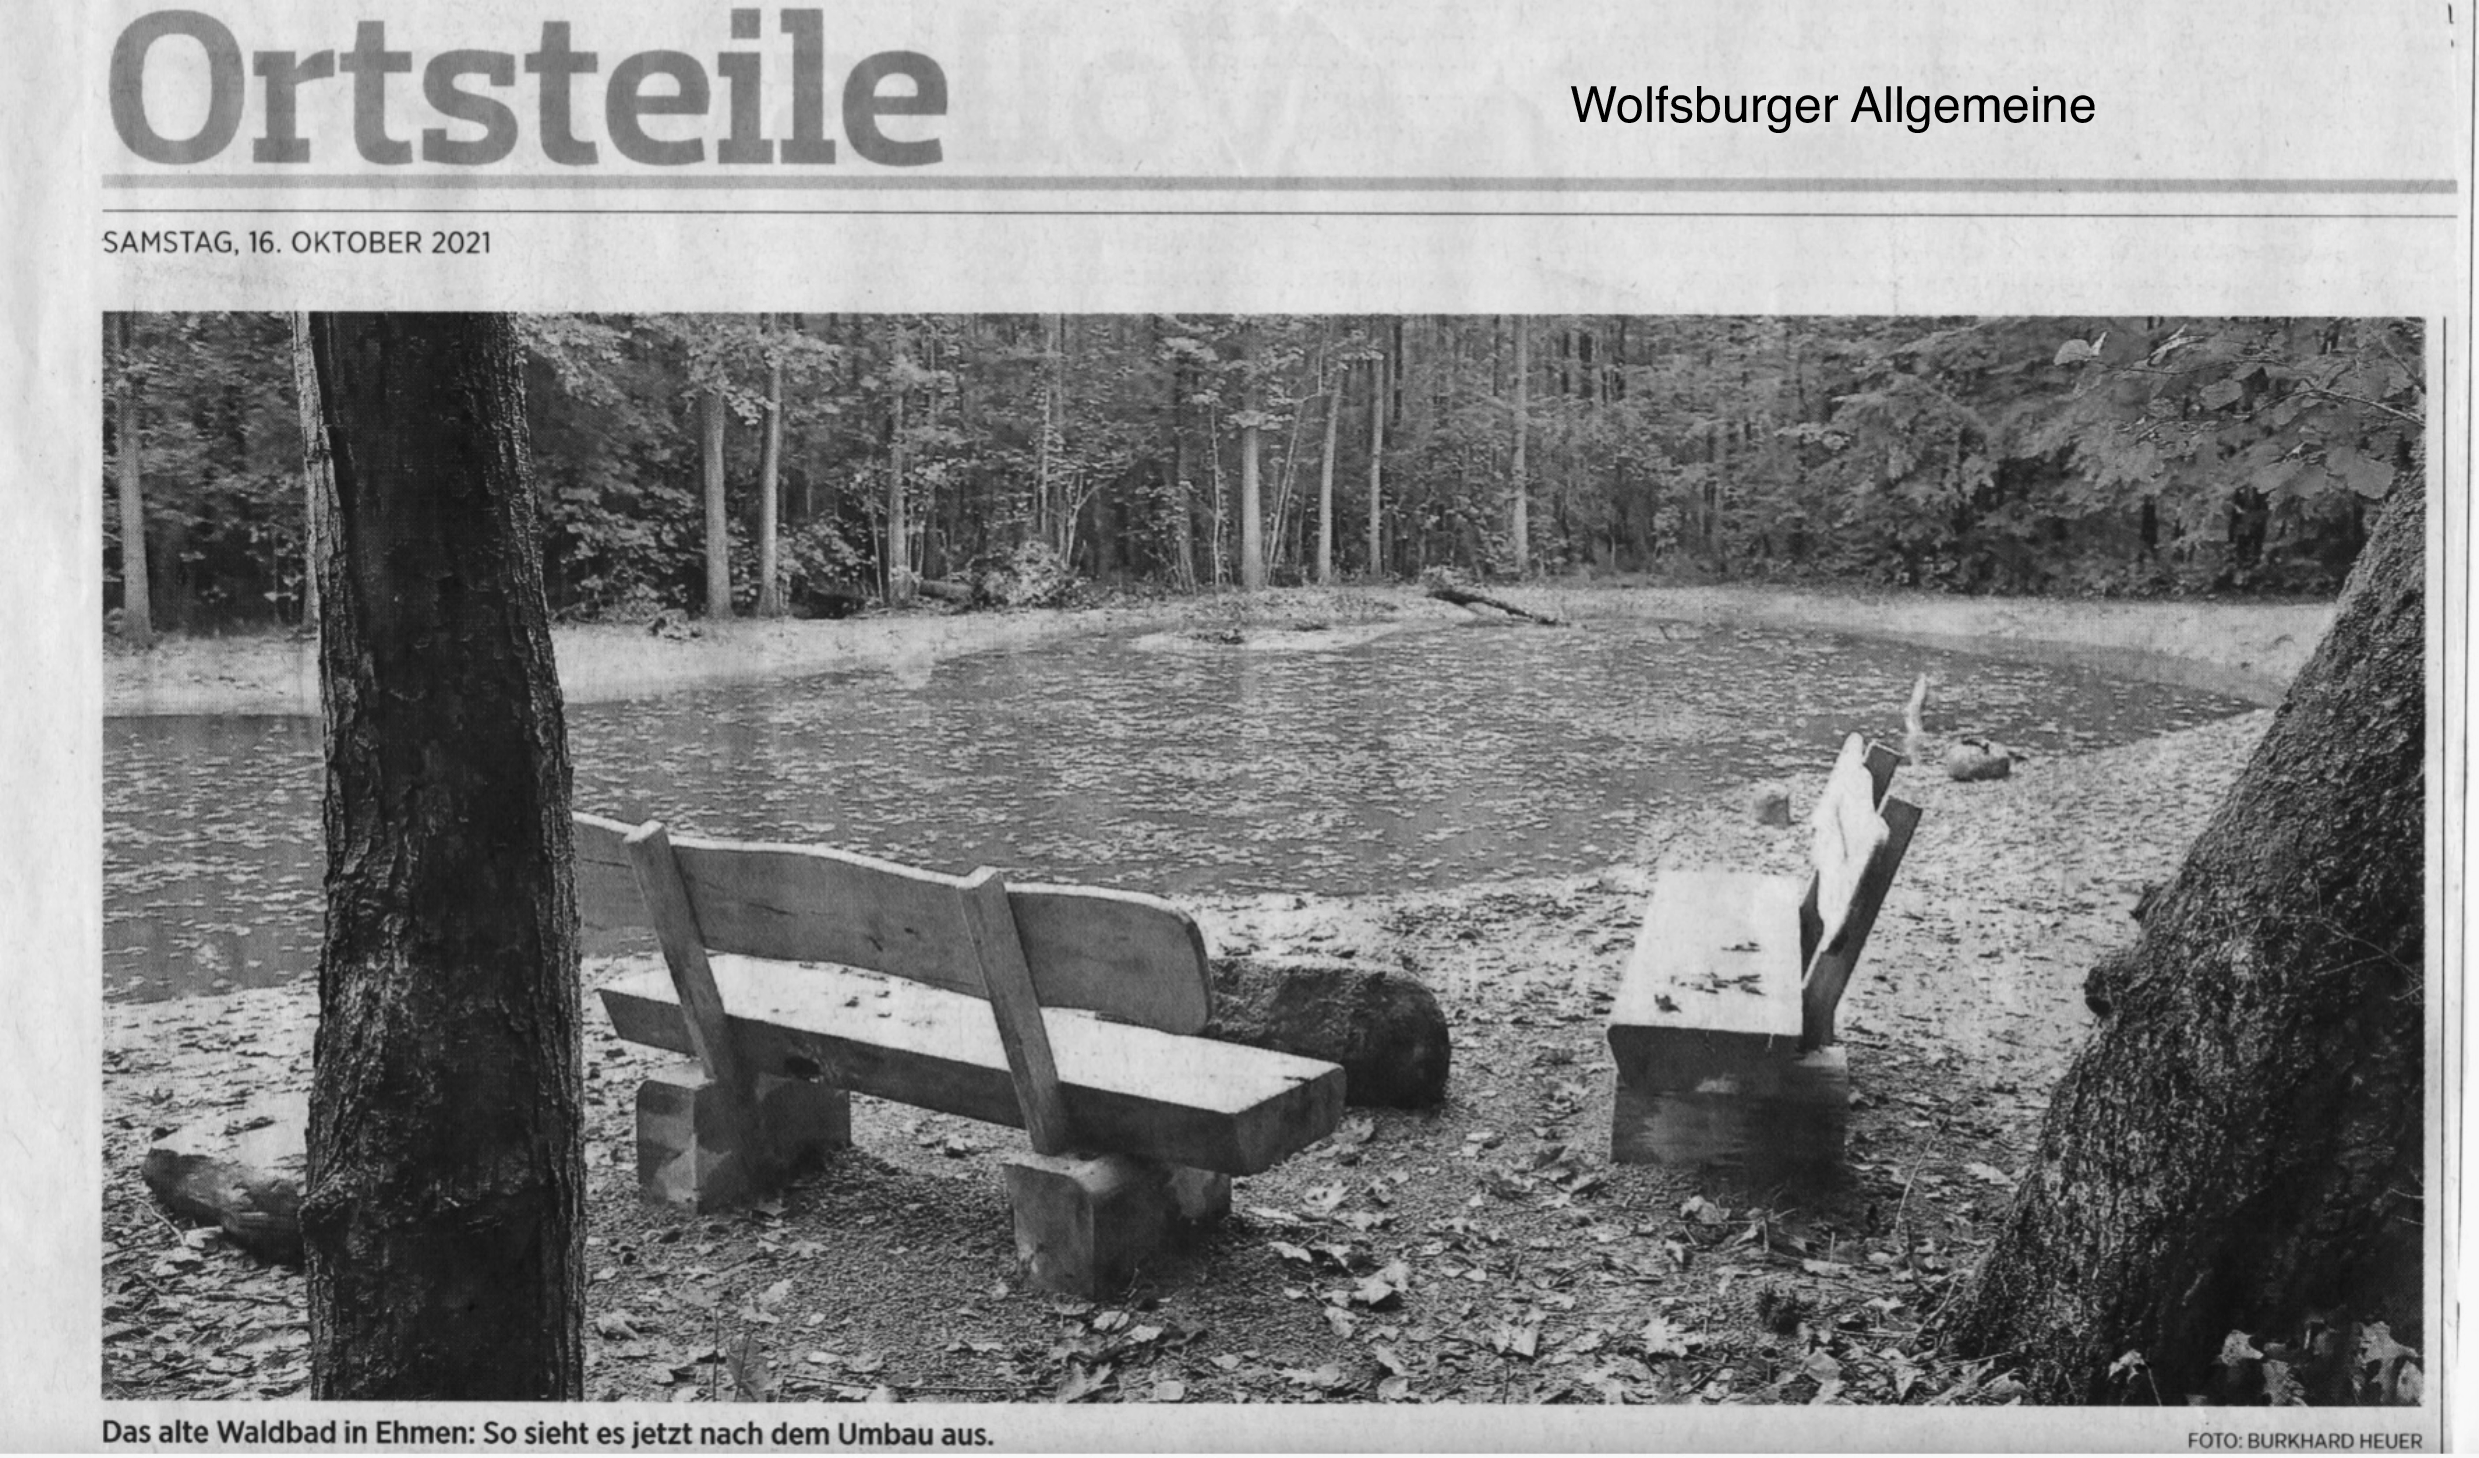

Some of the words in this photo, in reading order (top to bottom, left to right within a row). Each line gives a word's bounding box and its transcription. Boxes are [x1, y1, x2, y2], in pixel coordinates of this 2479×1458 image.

[109, 7, 949, 168] Ortsteile
[104, 230, 239, 257] SAMSTAG,
[248, 230, 281, 254] 16.
[291, 230, 422, 254] OKTOBER
[431, 230, 490, 255] 2021
[102, 1419, 152, 1443] Das
[159, 1420, 208, 1443] alte
[217, 1420, 336, 1443] Waldbad
[345, 1420, 367, 1443] in
[377, 1420, 474, 1444] Ehmen:
[484, 1421, 516, 1444] So
[525, 1421, 588, 1444] sieht
[597, 1427, 625, 1444] es
[632, 1422, 692, 1449] jetzt
[701, 1421, 762, 1445] nach
[772, 1422, 829, 1445] dem
[839, 1423, 933, 1446] Umbau
[941, 1427, 993, 1446] aus.
[2188, 1432, 2242, 1449] FOTO:
[2248, 1432, 2355, 1449] BURKHARD
[2359, 1432, 2423, 1450] HEUER
